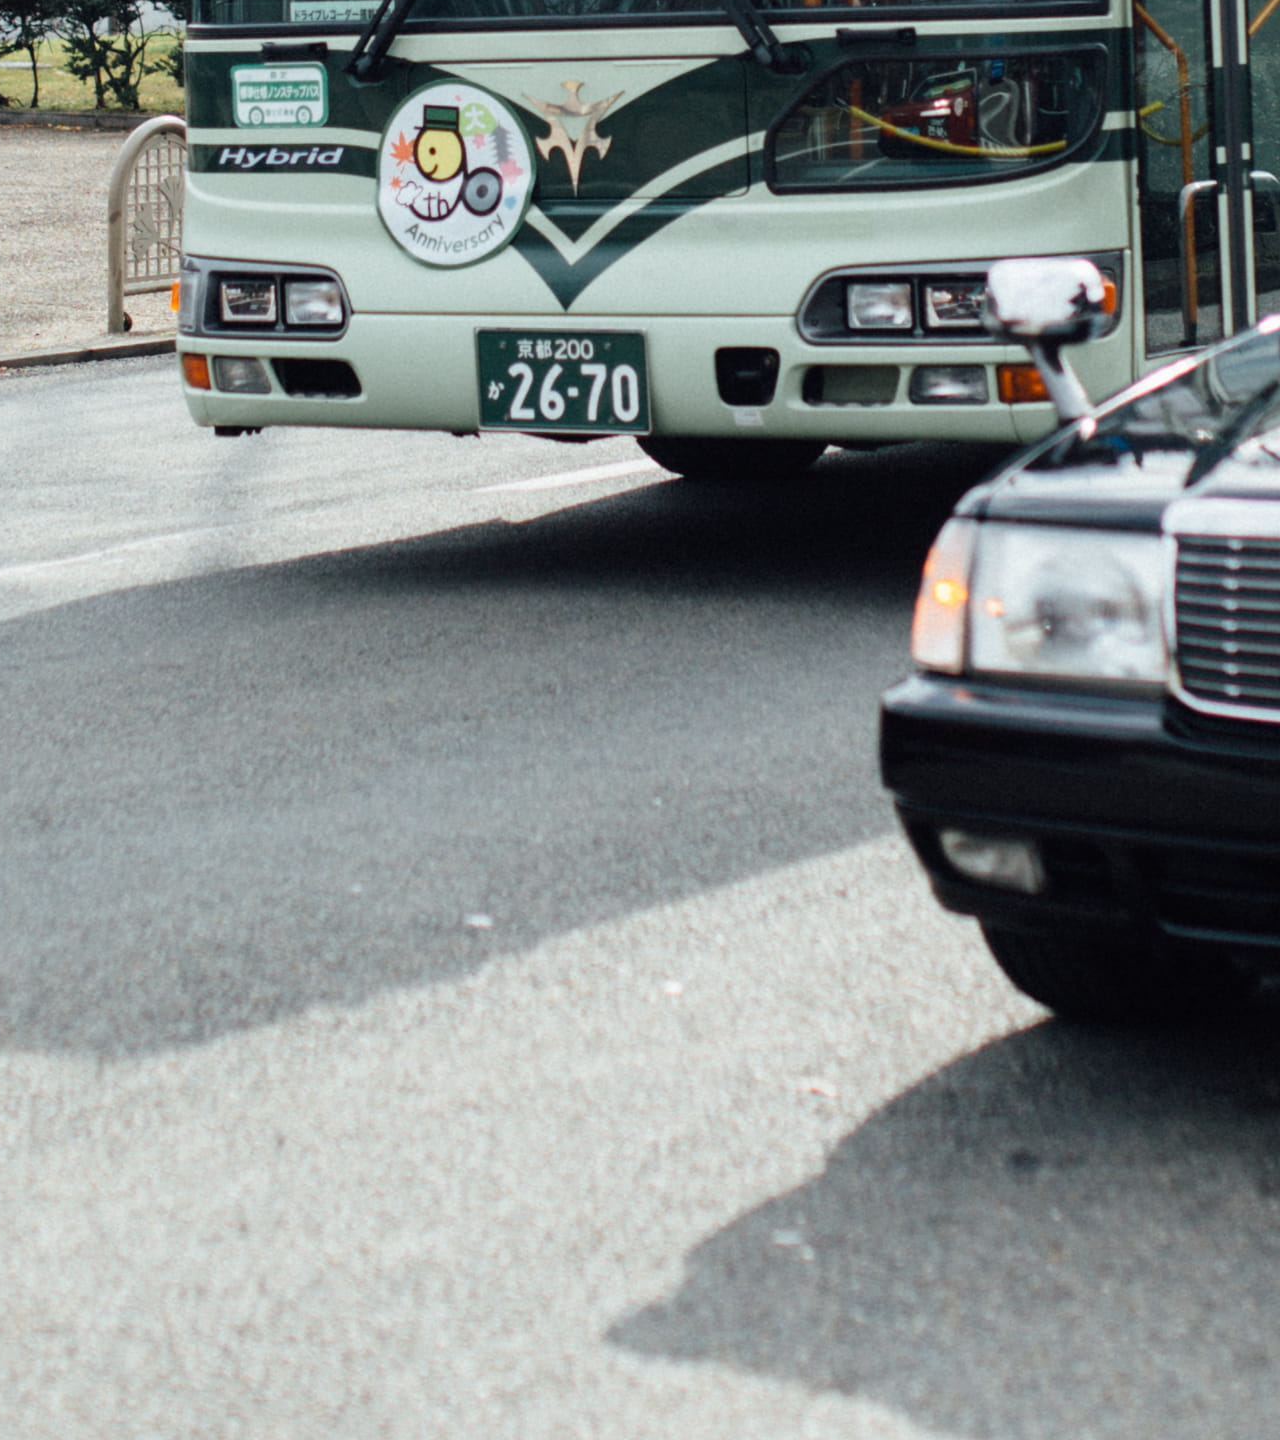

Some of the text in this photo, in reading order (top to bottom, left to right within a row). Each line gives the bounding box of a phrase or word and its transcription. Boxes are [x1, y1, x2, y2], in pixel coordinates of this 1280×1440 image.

[218, 146, 344, 169] Hybrid
[404, 213, 505, 254] Anniversary
[487, 361, 640, 423] か 26-70
